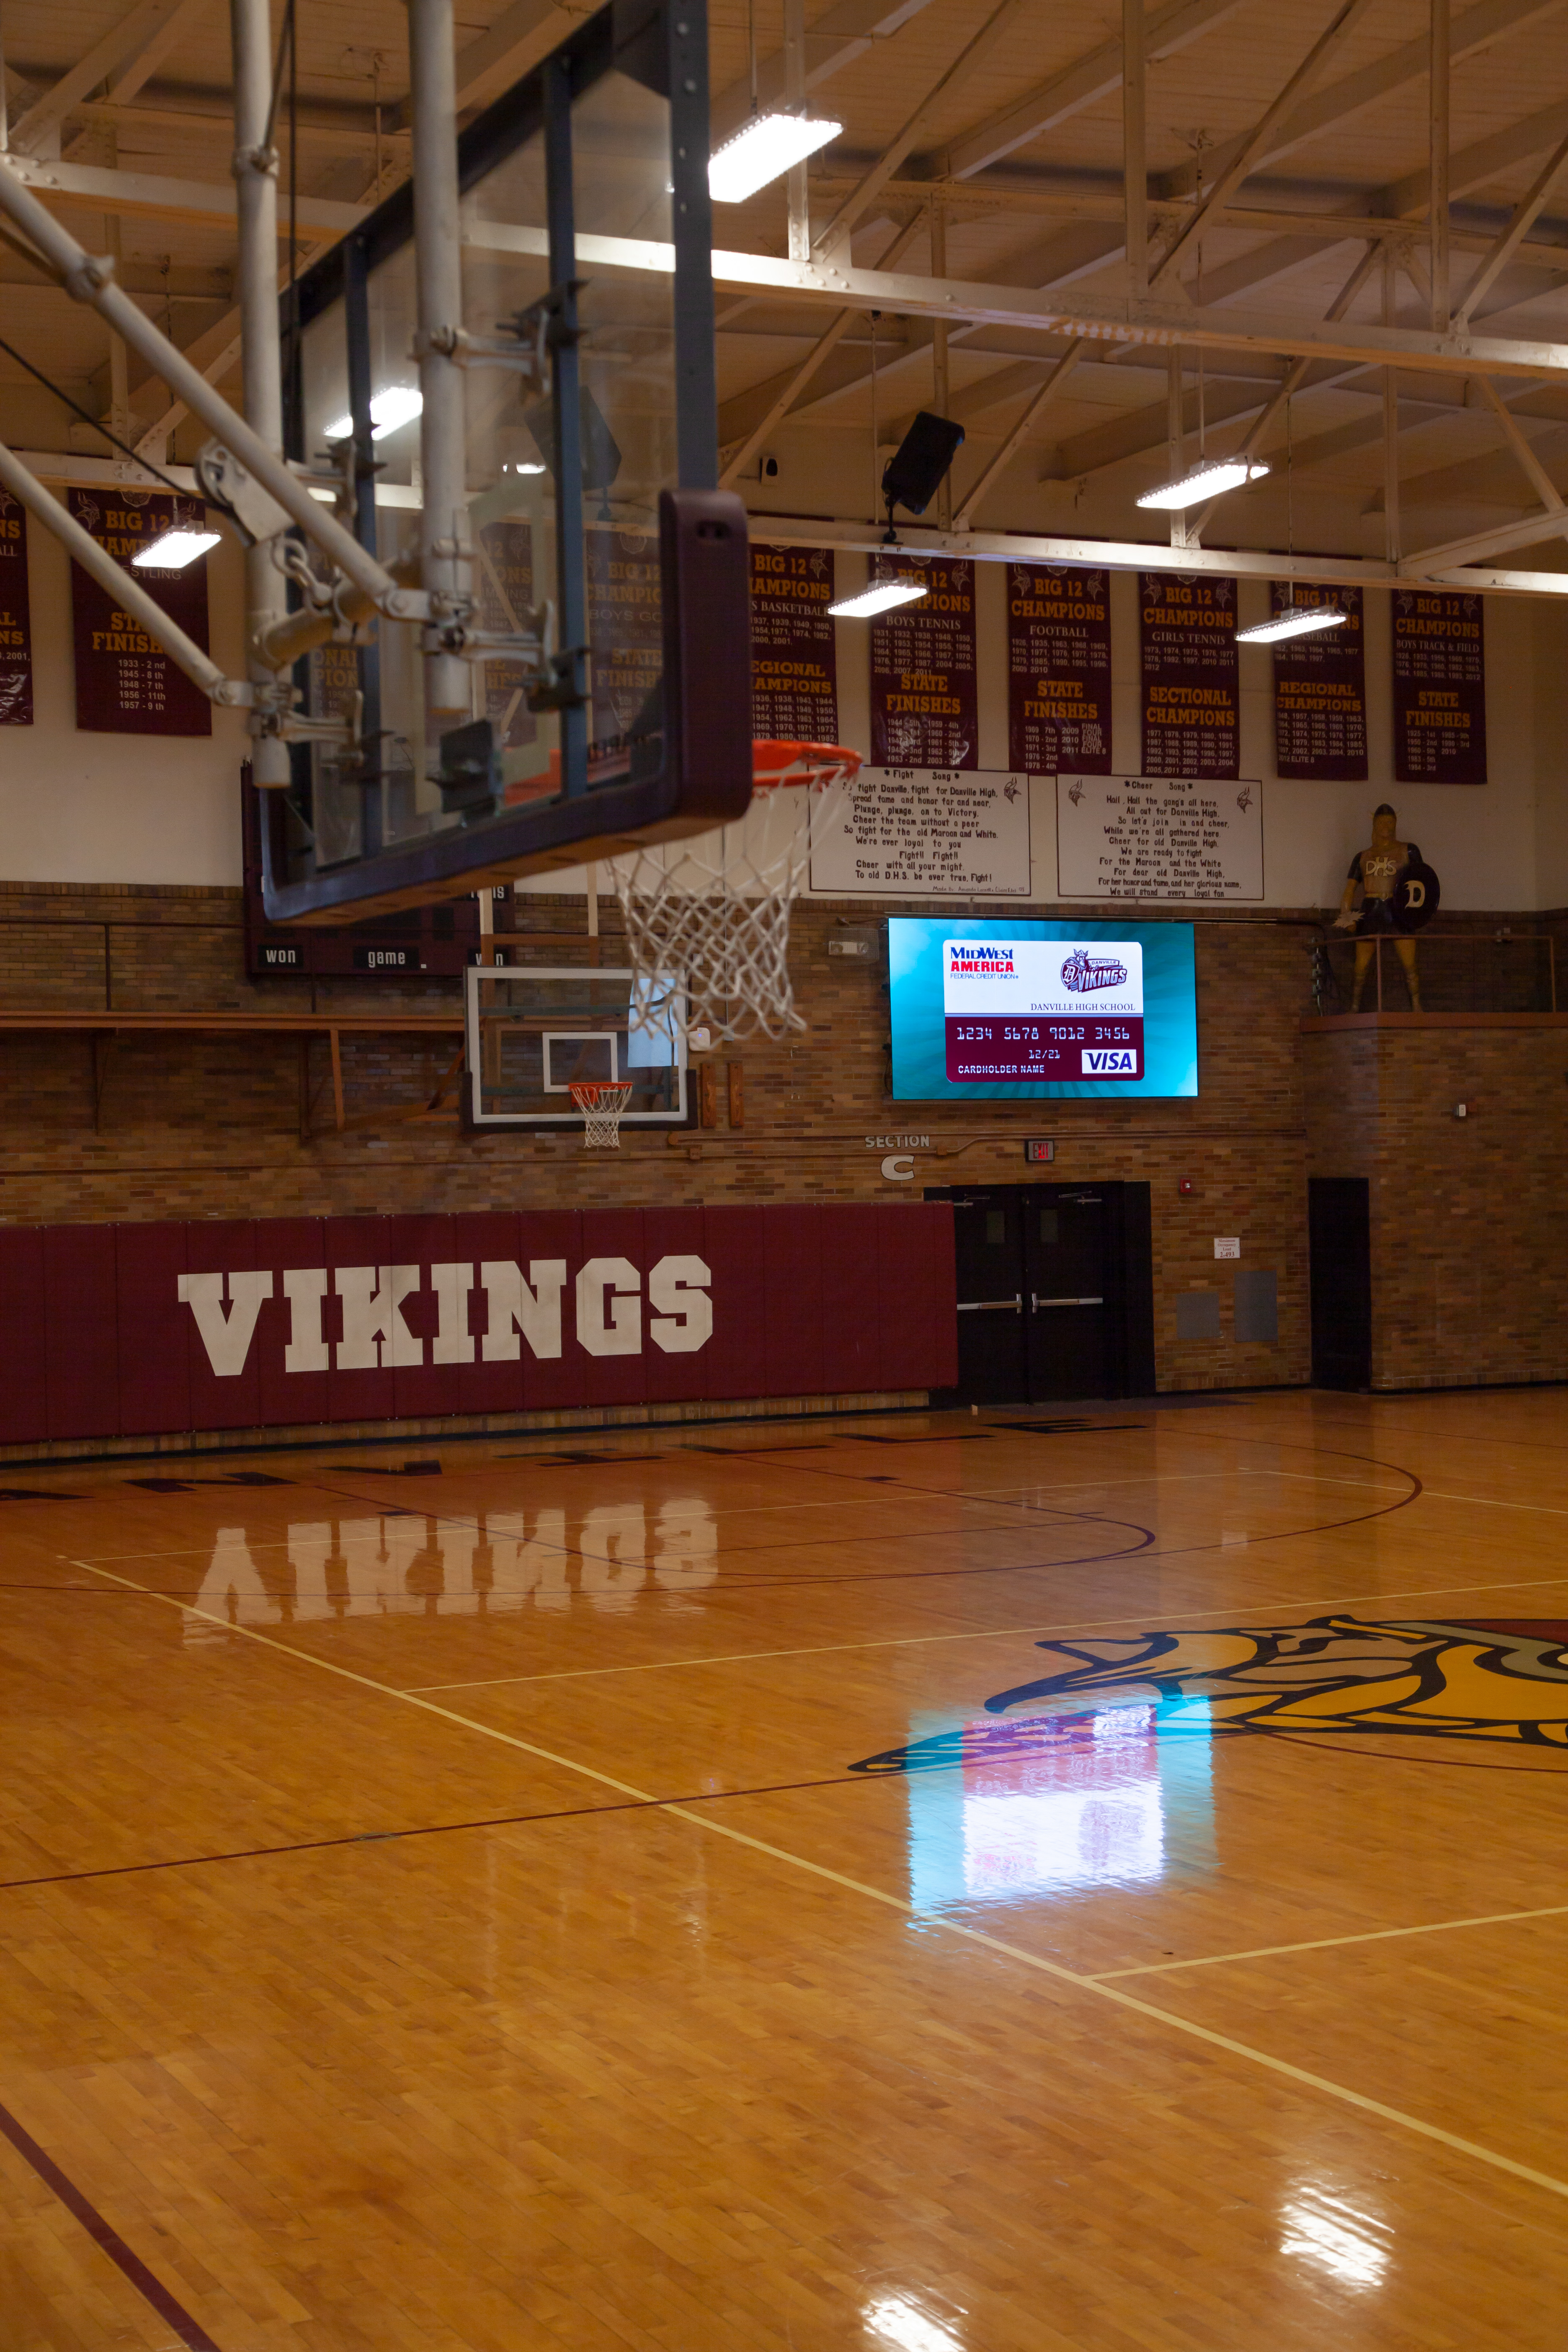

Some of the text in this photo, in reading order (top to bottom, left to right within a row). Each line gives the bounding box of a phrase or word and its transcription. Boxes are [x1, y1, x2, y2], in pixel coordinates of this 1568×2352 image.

[106, 511, 172, 534] BIG 12
[607, 562, 640, 581] BIG
[754, 554, 806, 575] BIG 12
[932, 571, 947, 588] 12
[1034, 578, 1082, 597] BIG 12
[1166, 587, 1212, 604] BIG 12
[1295, 590, 1338, 606] BIG 12
[1011, 600, 1105, 621] CHAMPIONS
[1417, 598, 1460, 615] BIG 12
[885, 614, 961, 629] BOYS TENNIS
[1143, 608, 1233, 628] CHAMPIONS
[1030, 625, 1088, 637] FOOTBALL
[1396, 618, 1479, 638] CHAMPIONS
[92, 630, 166, 654] FINISH
[1152, 632, 1225, 645] GIRLS TENNIS
[1396, 639, 1479, 653] BOYS TRACK & FIELD
[6, 652, 30, 661] 2001,
[119, 659, 139, 668] 1933
[751, 660, 825, 677] EGIONAL
[597, 671, 660, 687] FINISH
[754, 677, 832, 694] AMPIONS
[901, 673, 948, 692] STATE
[1038, 680, 1083, 698] STATE
[1150, 686, 1231, 706] SECTIONAL
[1279, 681, 1356, 696] REGIONAL
[120, 701, 139, 709] 1957
[886, 694, 961, 714] FINISHES
[1277, 697, 1362, 712] CHAMPIONS
[1418, 691, 1458, 707] STATE
[1024, 701, 1098, 719] FINISHES
[1146, 707, 1235, 726] CHAMPIONS
[1406, 710, 1470, 727] FINISHES
[893, 769, 951, 782] Fight Song
[1132, 781, 1185, 792] Cheer Song
[1126, 806, 1135, 814] All
[1171, 807, 1199, 817] Danville
[1202, 808, 1220, 818] High.
[853, 815, 877, 824] Cheer
[881, 816, 894, 825] the
[897, 817, 916, 825] team
[921, 818, 949, 827] without
[962, 821, 980, 830] peer
[844, 825, 853, 834] So
[858, 825, 877, 836] fight
[880, 826, 892, 835] for
[897, 827, 910, 836] the
[917, 828, 928, 836] old
[931, 828, 957, 837] Maroon
[975, 830, 998, 838] White.
[856, 836, 877, 845] We're
[905, 838, 923, 849] loyal
[933, 839, 941, 847] to
[949, 842, 961, 850] you
[1109, 836, 1131, 845] Cheer
[1171, 838, 1197, 847] Danville
[1202, 838, 1219, 849] High.
[1153, 848, 1173, 859] ready
[1176, 848, 1184, 857] to
[1186, 849, 1202, 859] fight
[1099, 857, 1113, 865] For
[1135, 857, 1161, 866] Maroon
[1169, 859, 1181, 867] and
[1200, 859, 1221, 867] White
[1365, 856, 1397, 877] DHS
[855, 869, 864, 879] To
[868, 870, 879, 879] old
[885, 871, 908, 880] D.H.S.
[914, 872, 922, 880] be
[950, 873, 968, 882] true.
[971, 873, 992, 884] Fight!
[1110, 887, 1121, 895] We
[1405, 880, 1426, 908] D
[266, 950, 296, 963] won
[368, 952, 405, 968] game
[476, 952, 503, 966] wn
[951, 961, 1014, 972] AMERICA
[1078, 968, 1127, 992] VIKINGS
[957, 1027, 1130, 1040] 1234 5678 9012 3456
[1029, 1050, 1060, 1059] 12/21
[1085, 1053, 1132, 1070] VISA
[958, 1065, 1044, 1074] CARDHOLDER NAME
[865, 1136, 929, 1148] SECTION
[1033, 1143, 1049, 1159] EXIT
[880, 1154, 915, 1181] C
[178, 1255, 714, 1377] VIKINGS
